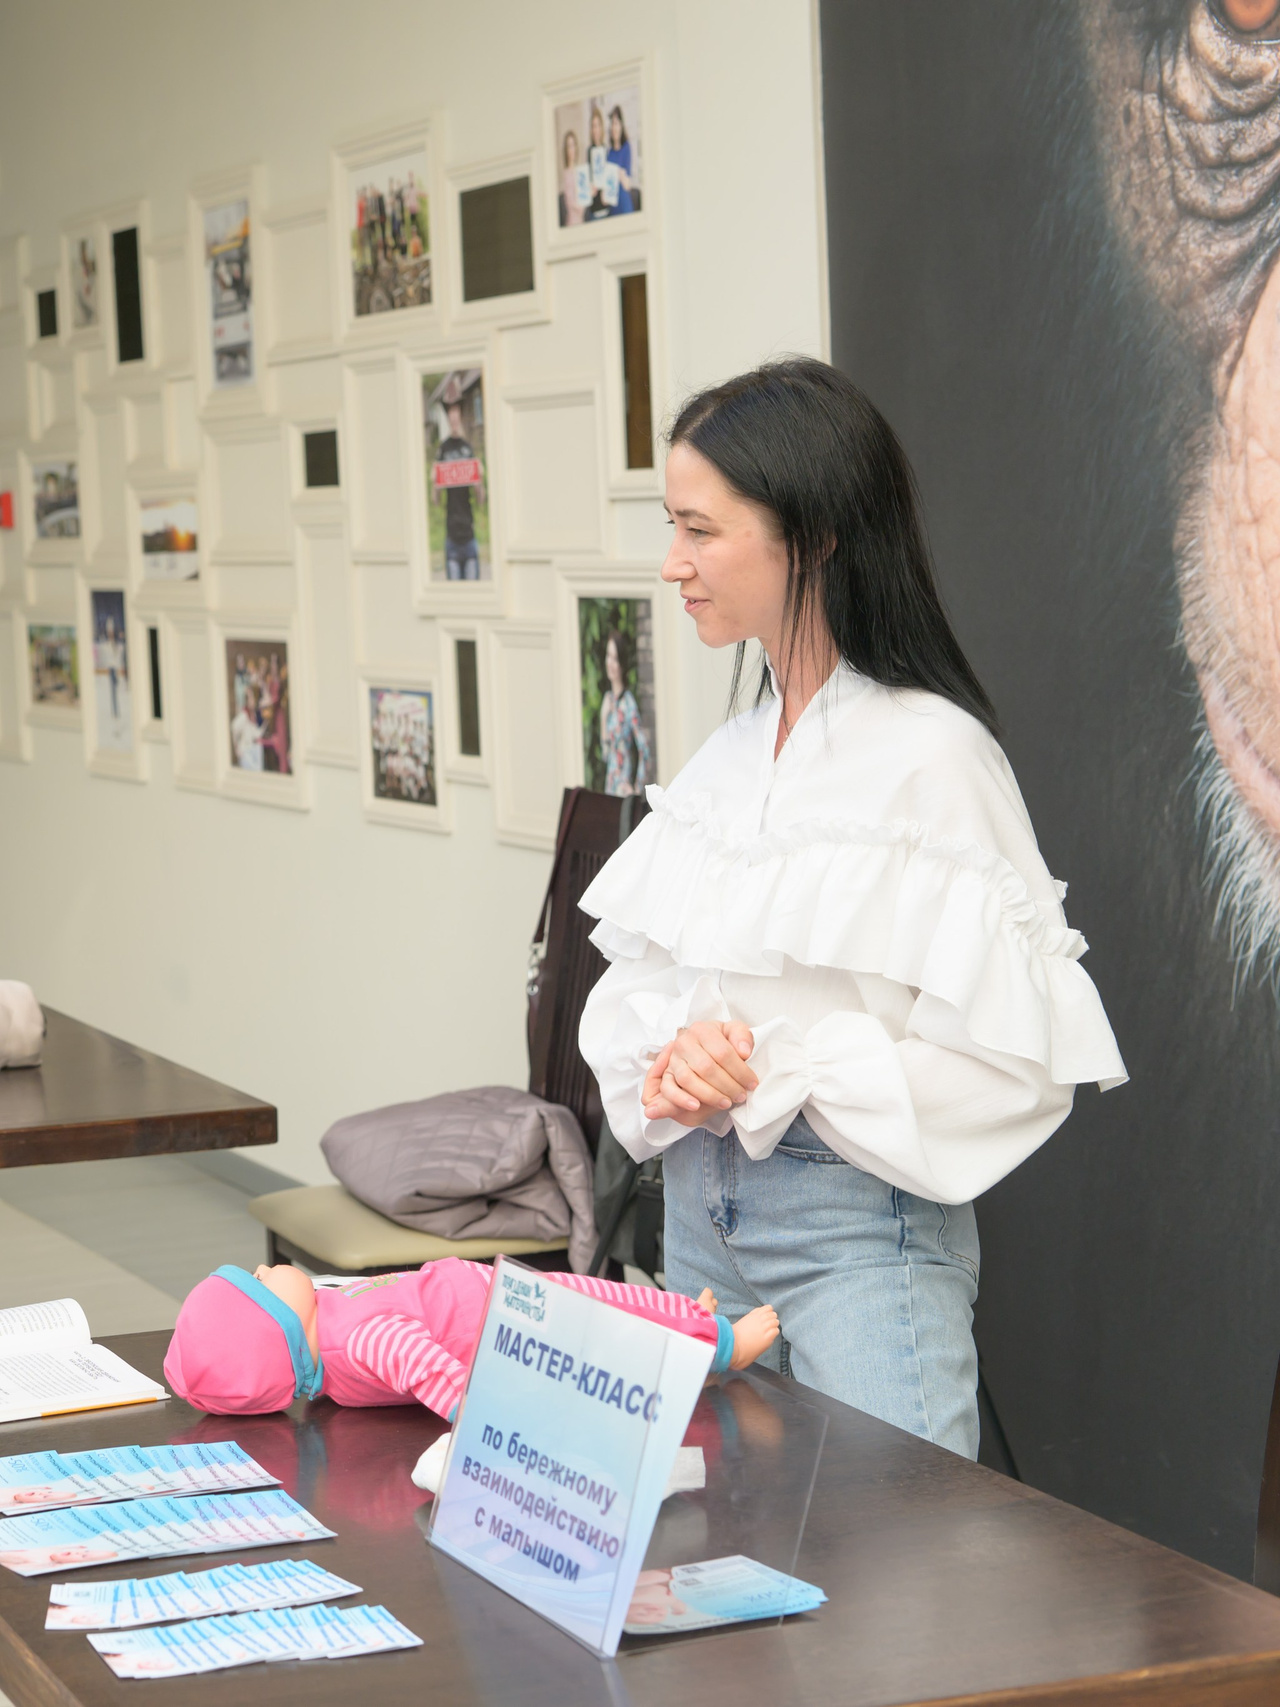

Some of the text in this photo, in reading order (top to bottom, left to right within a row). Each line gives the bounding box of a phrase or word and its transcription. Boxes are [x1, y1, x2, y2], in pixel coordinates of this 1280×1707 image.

[494, 1323, 662, 1423] МАСТЕР-КЛАСС
[461, 1455, 619, 1558] взаимодействию
[481, 1424, 618, 1516] по бережному
[474, 1506, 581, 1583] с малышом
